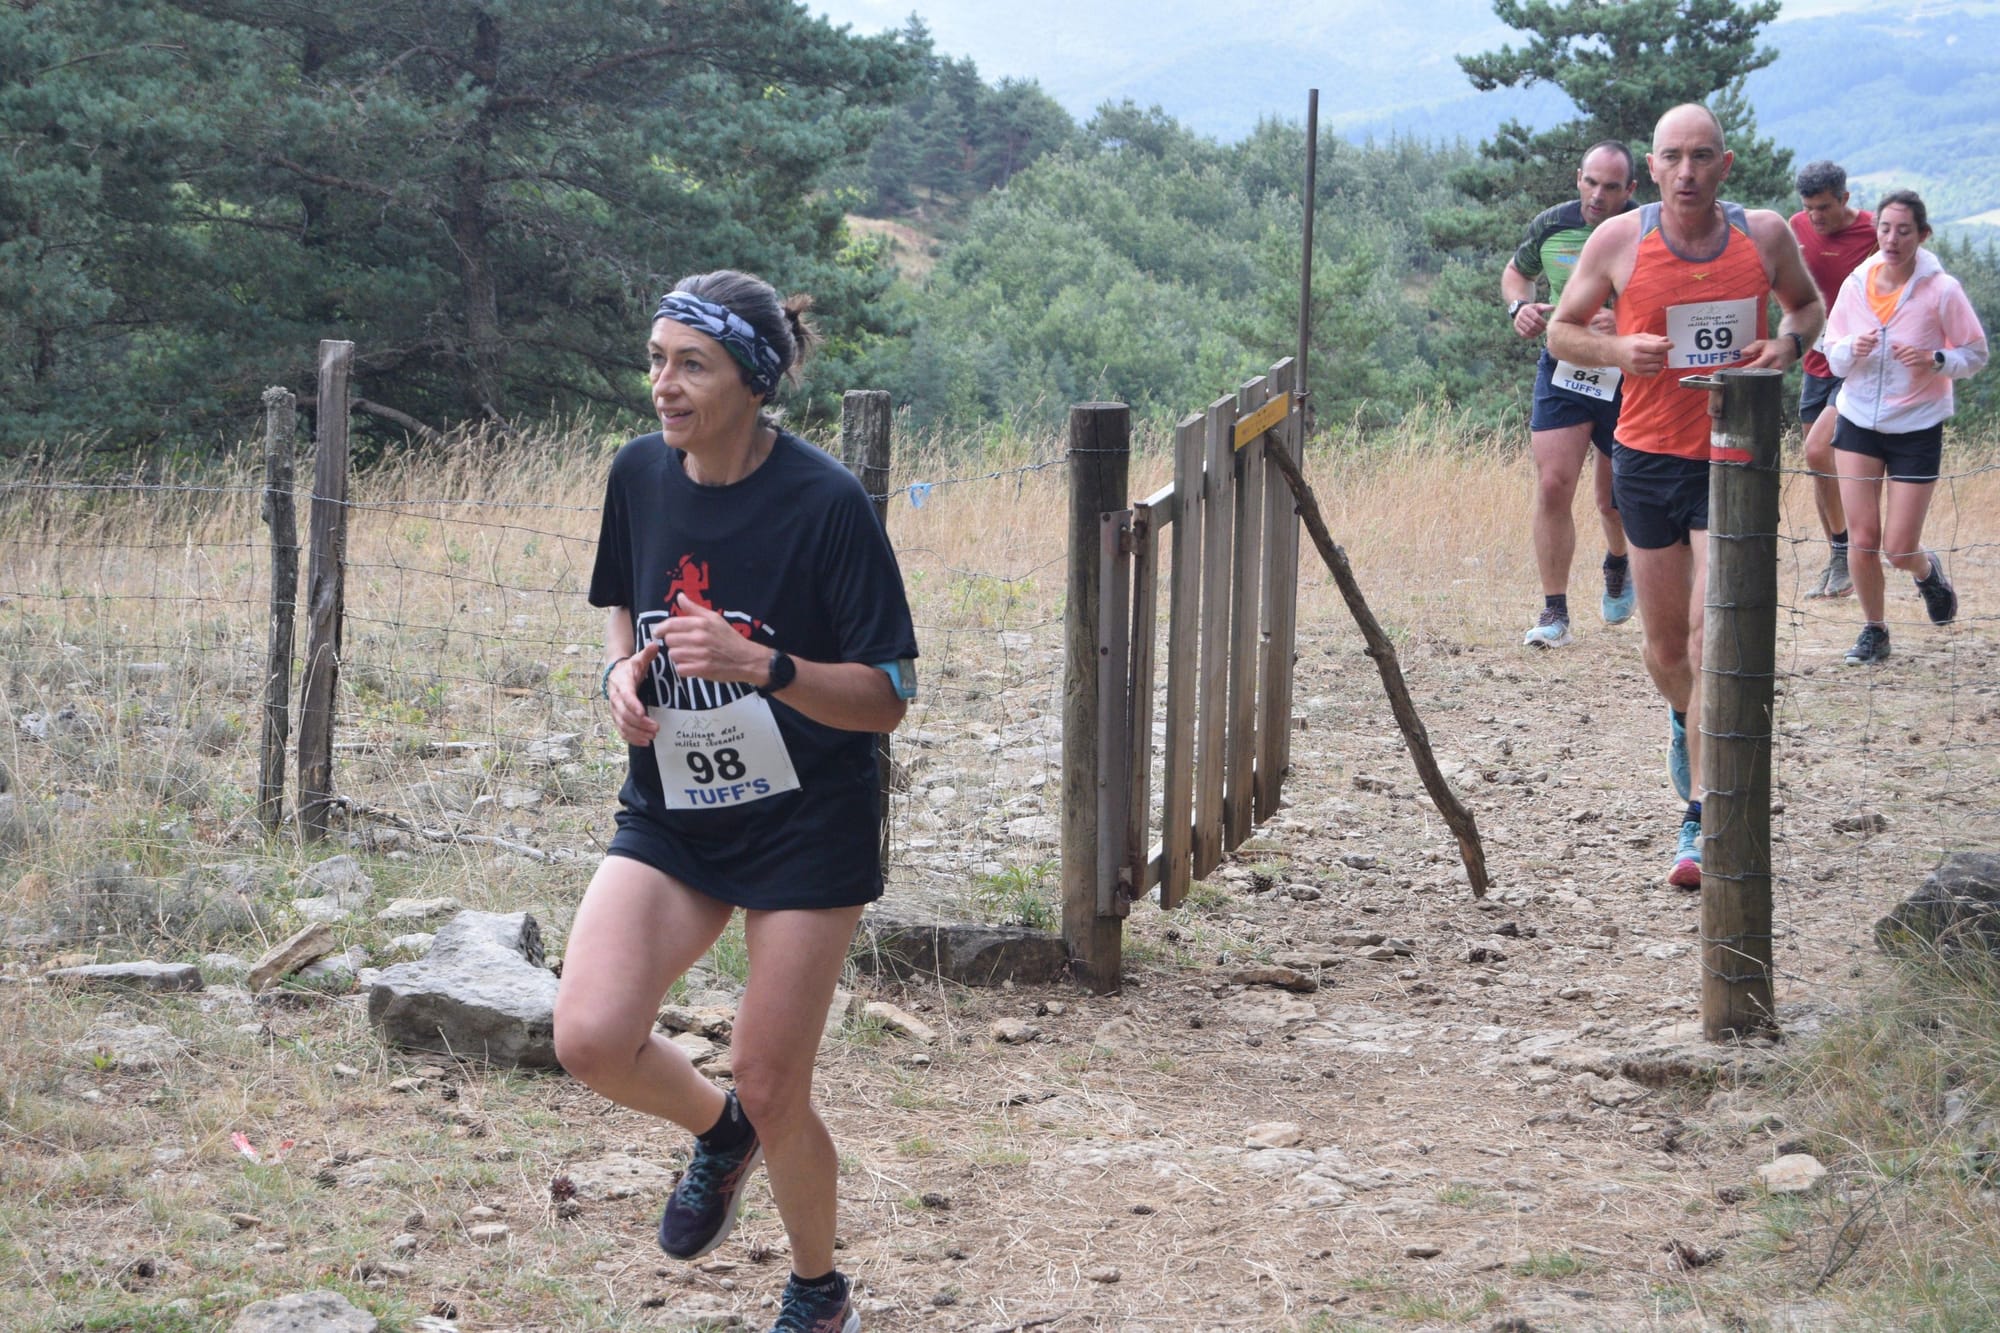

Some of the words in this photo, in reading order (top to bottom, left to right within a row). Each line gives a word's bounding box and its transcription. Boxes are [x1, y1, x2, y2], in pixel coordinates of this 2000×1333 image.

[1694, 327, 1733, 351] 69
[1685, 350, 1742, 365] TUFF'S
[1573, 370, 1600, 385] 84
[1564, 379, 1602, 397] TUFF'S
[676, 730, 716, 741] Challenge
[721, 725, 737, 736] des
[686, 748, 746, 784] 98
[684, 778, 771, 806] TUFF'S
